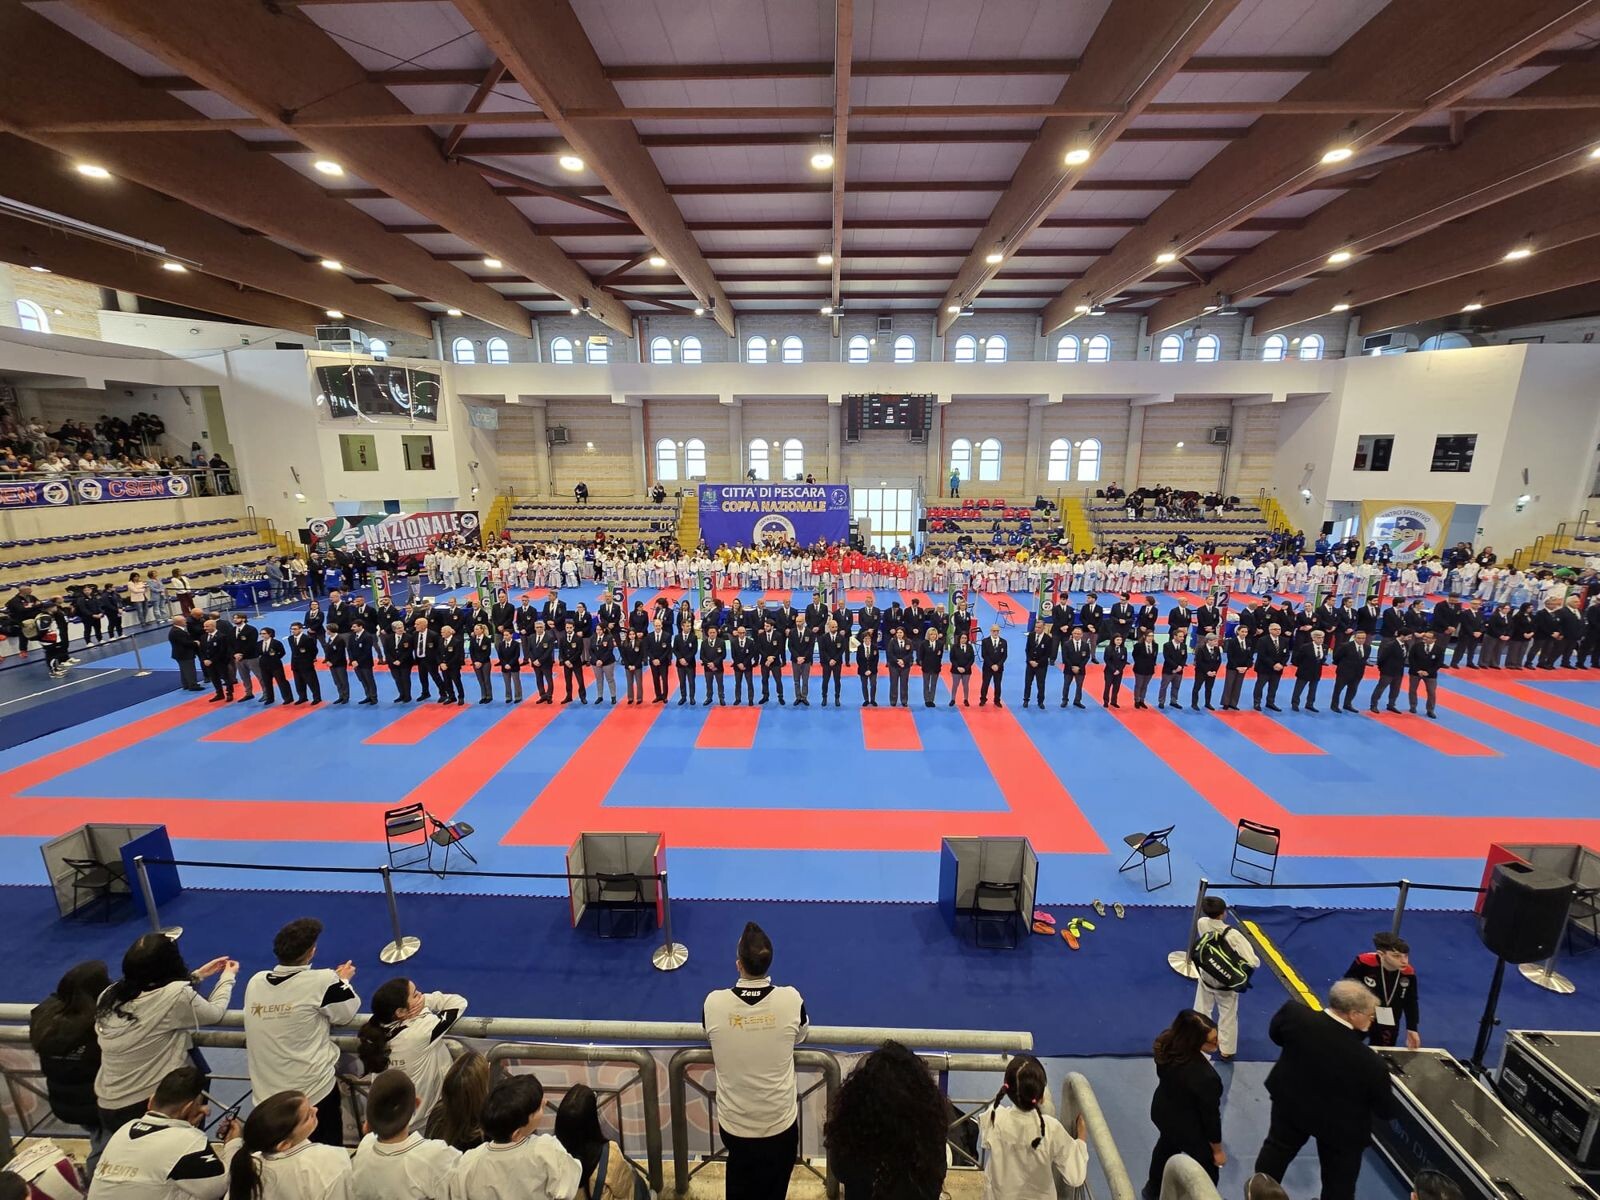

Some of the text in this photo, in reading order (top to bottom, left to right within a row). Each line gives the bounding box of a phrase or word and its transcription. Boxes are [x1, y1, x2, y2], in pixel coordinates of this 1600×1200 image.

[109, 480, 164, 497] CSEN
[722, 487, 826, 498] CITTA' DI PESCARA
[721, 501, 760, 513] COPPA
[761, 501, 826, 513] NAZIONALE
[362, 513, 461, 545] NAZIONALE
[394, 537, 428, 551] KARATE
[373, 576, 385, 591] 9
[480, 576, 489, 590] 4
[702, 577, 714, 591] 3
[1043, 578, 1055, 593] 2
[612, 587, 625, 602] 5
[820, 588, 836, 604] 11
[1213, 591, 1229, 607] 12
